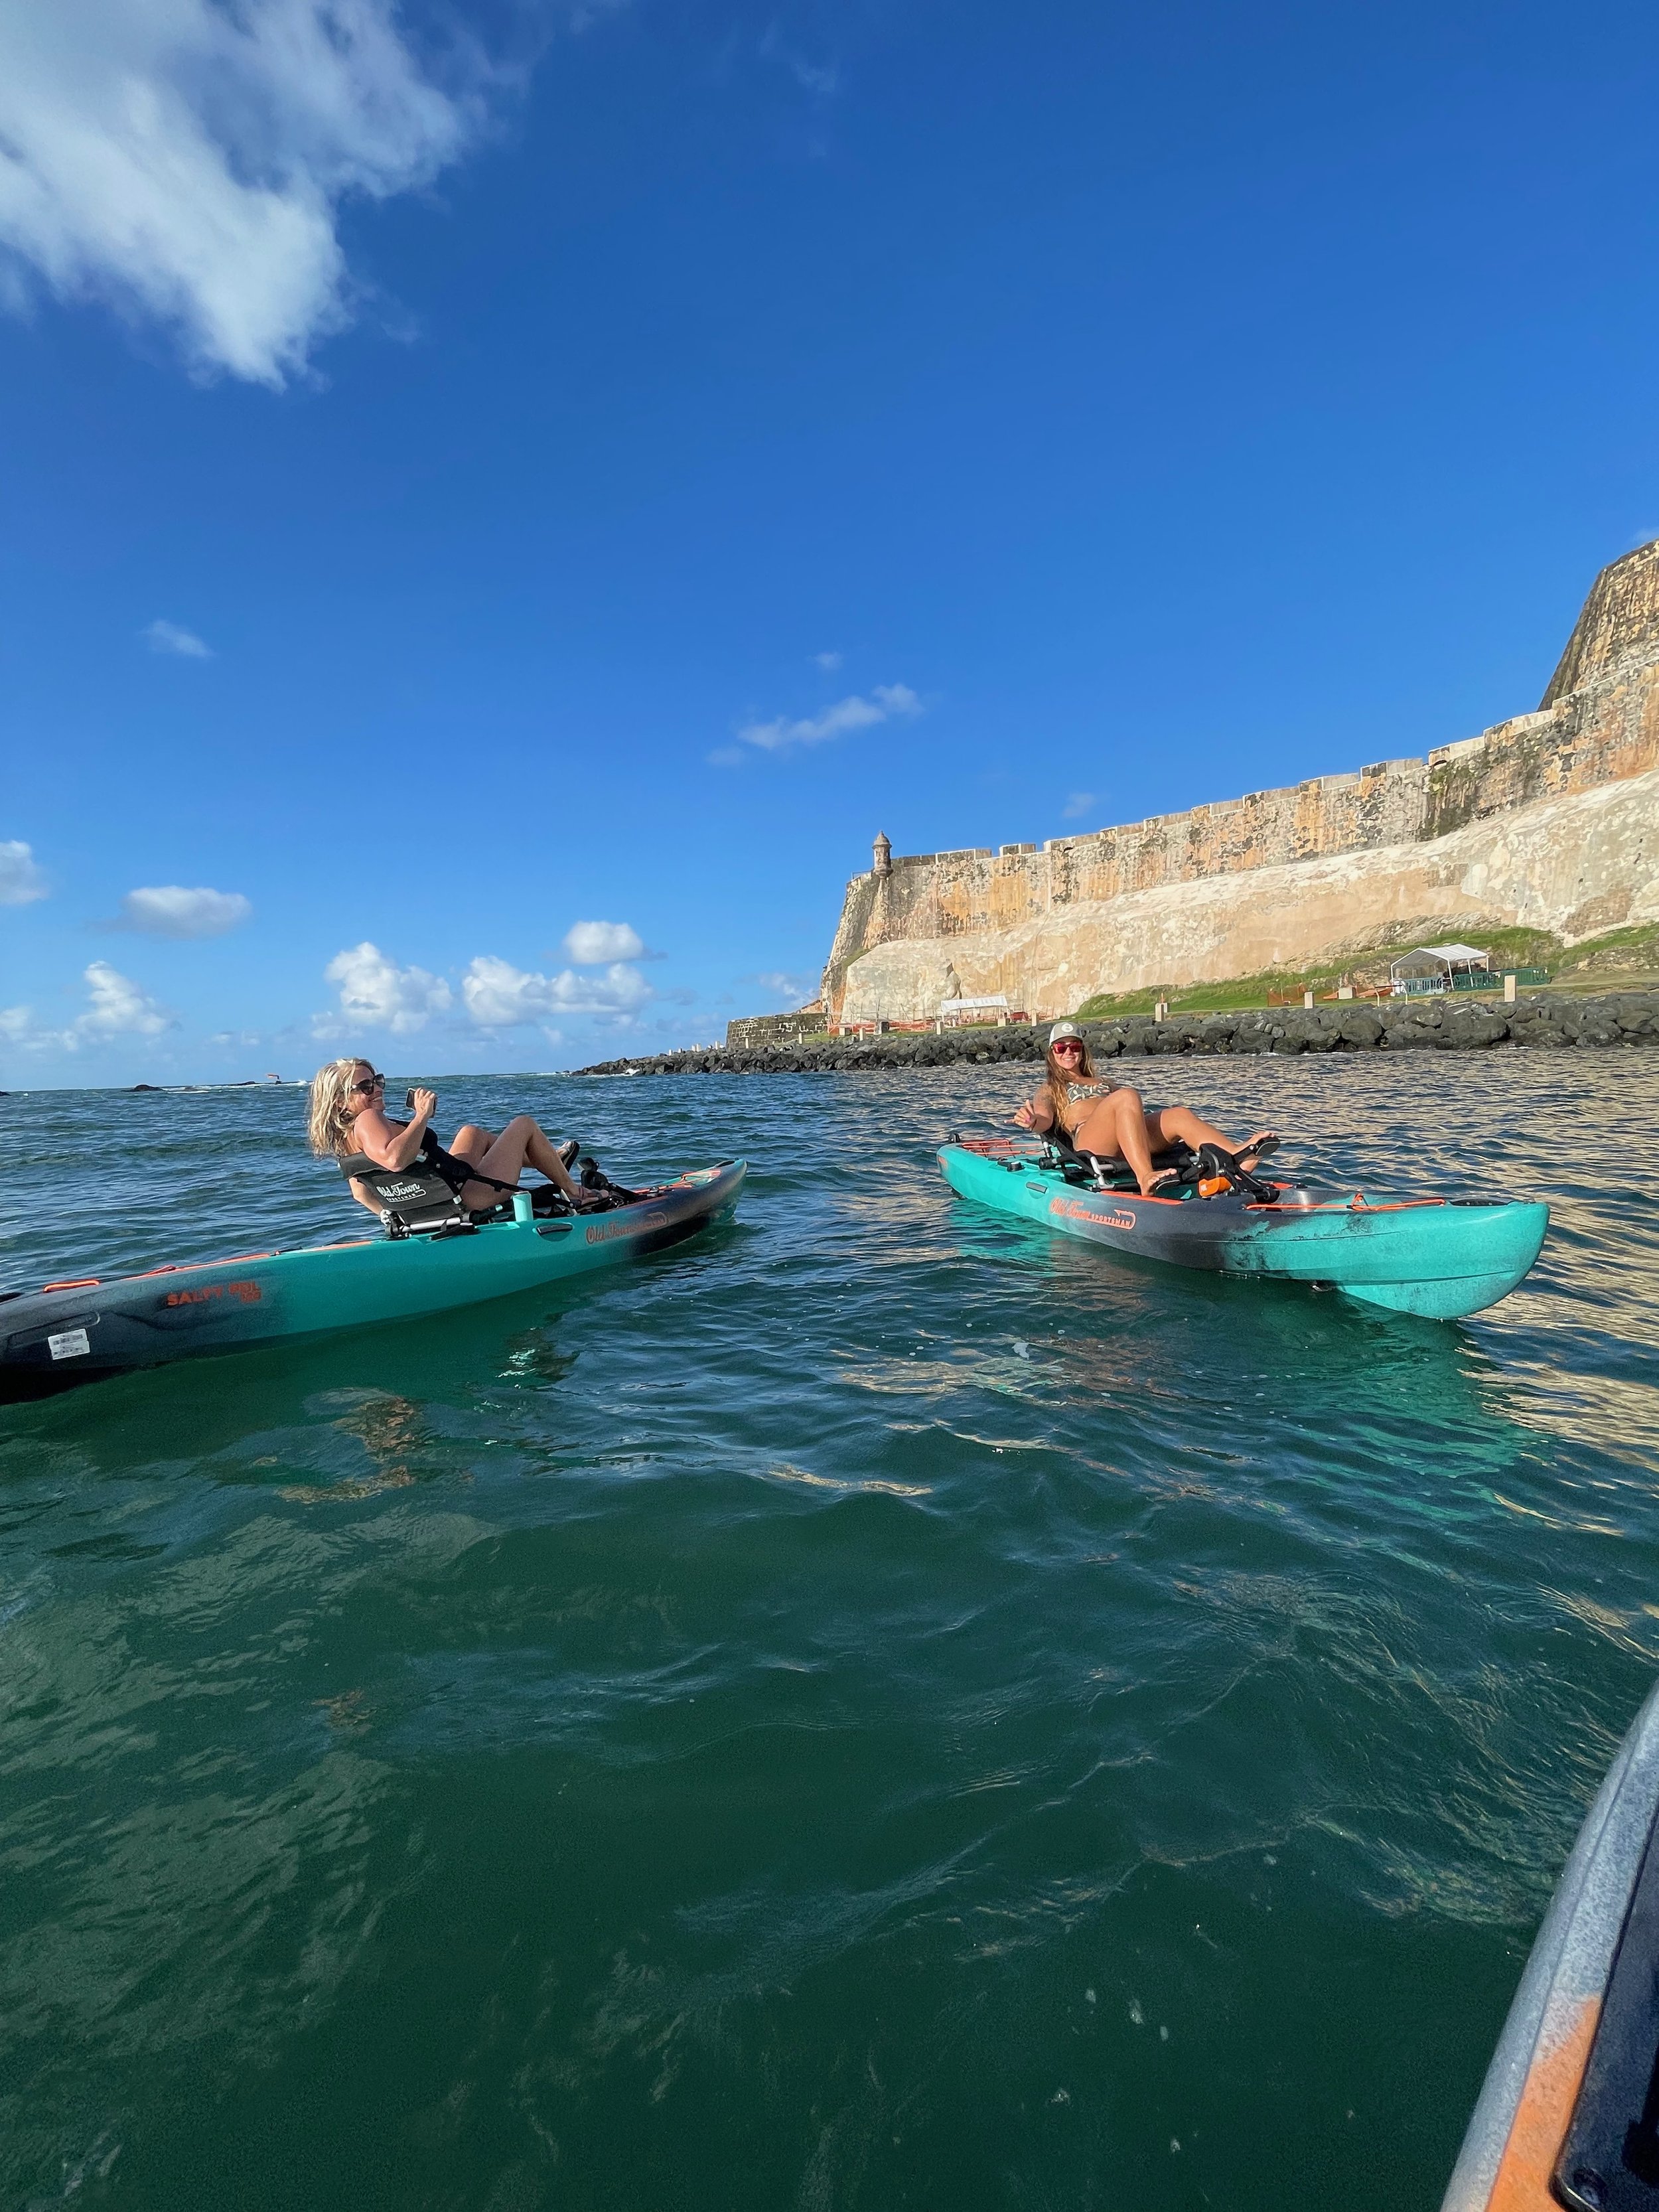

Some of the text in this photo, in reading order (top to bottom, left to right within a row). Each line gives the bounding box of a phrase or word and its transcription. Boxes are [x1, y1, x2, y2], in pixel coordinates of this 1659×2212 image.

[376, 1181, 420, 1197] Old Town
[1050, 1197, 1131, 1227] Old Town SPORTSMAN
[586, 1224, 605, 1244] Old
[167, 1286, 224, 1307] SALTY
